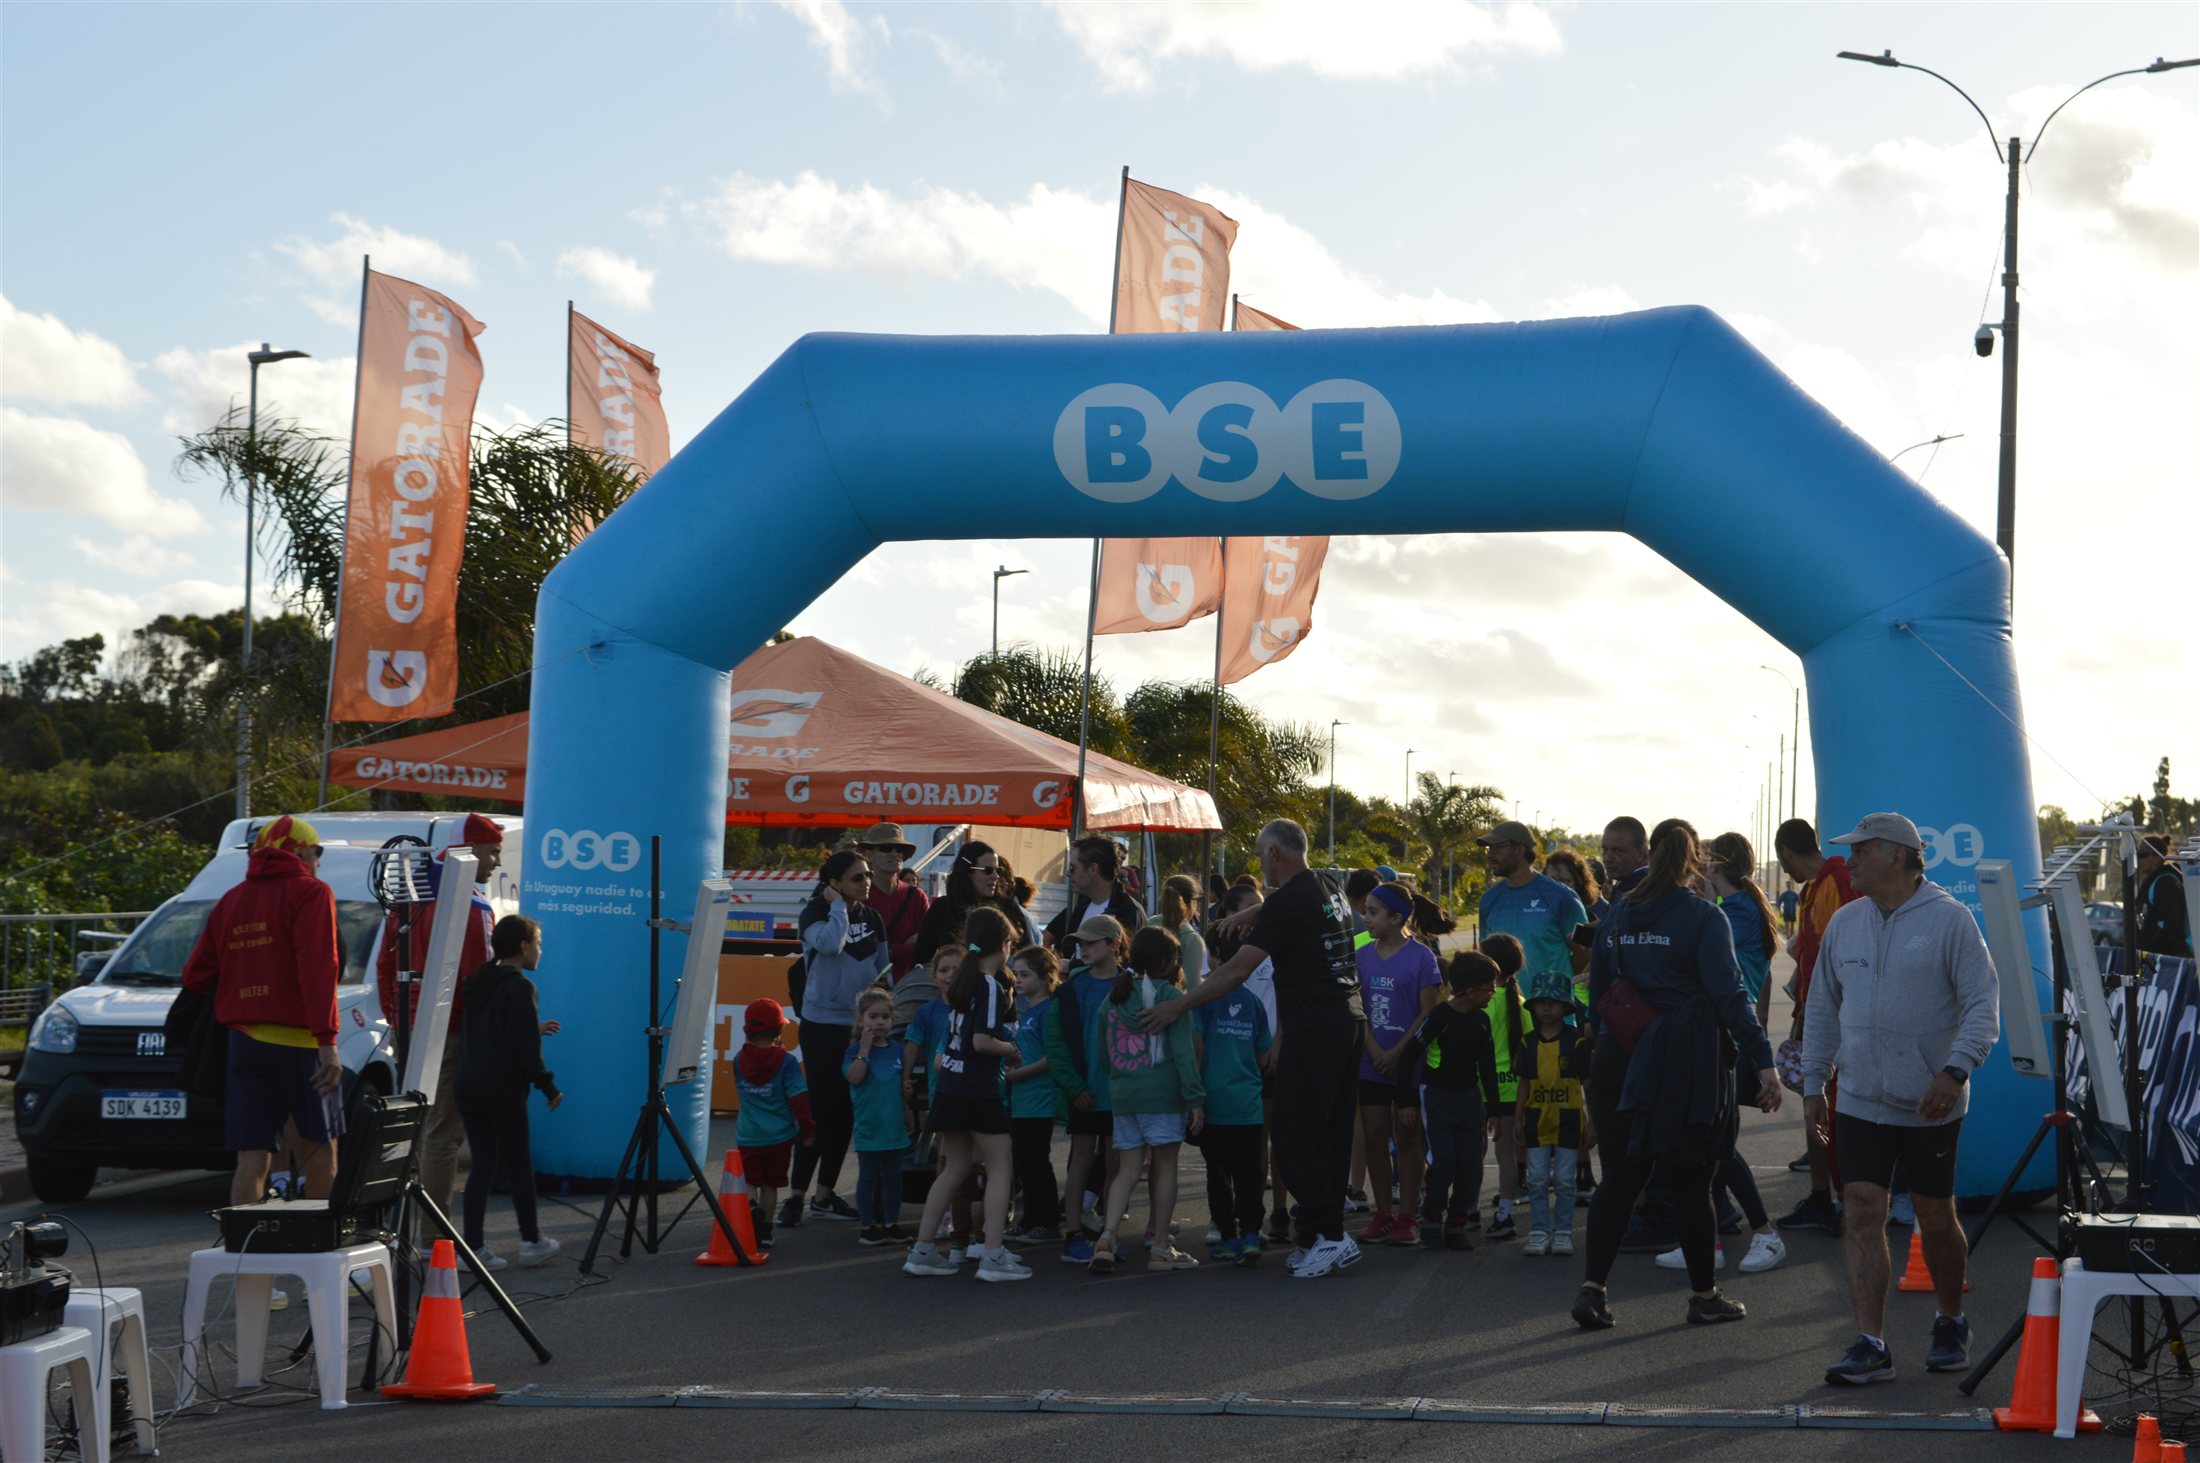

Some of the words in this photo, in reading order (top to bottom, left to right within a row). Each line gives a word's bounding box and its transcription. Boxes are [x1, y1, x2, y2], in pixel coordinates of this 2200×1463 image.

[1082, 399, 1371, 486] BSE
[385, 299, 452, 624] GATORADE
[1134, 562, 1196, 624] G
[366, 650, 427, 708] G
[355, 756, 508, 790] GATORADE
[784, 775, 810, 803] G
[843, 780, 1001, 806] GATORADE
[1032, 780, 1059, 808] G
[546, 834, 631, 867] BSE
[534, 881, 582, 898] Uruguay
[585, 882, 626, 898] nadie
[629, 886, 644, 899] te
[537, 899, 560, 911] más
[561, 901, 636, 916] seguridad.
[1638, 932, 1671, 946] Elena
[106, 1099, 136, 1117] SDK
[142, 1099, 182, 1117] 4139
